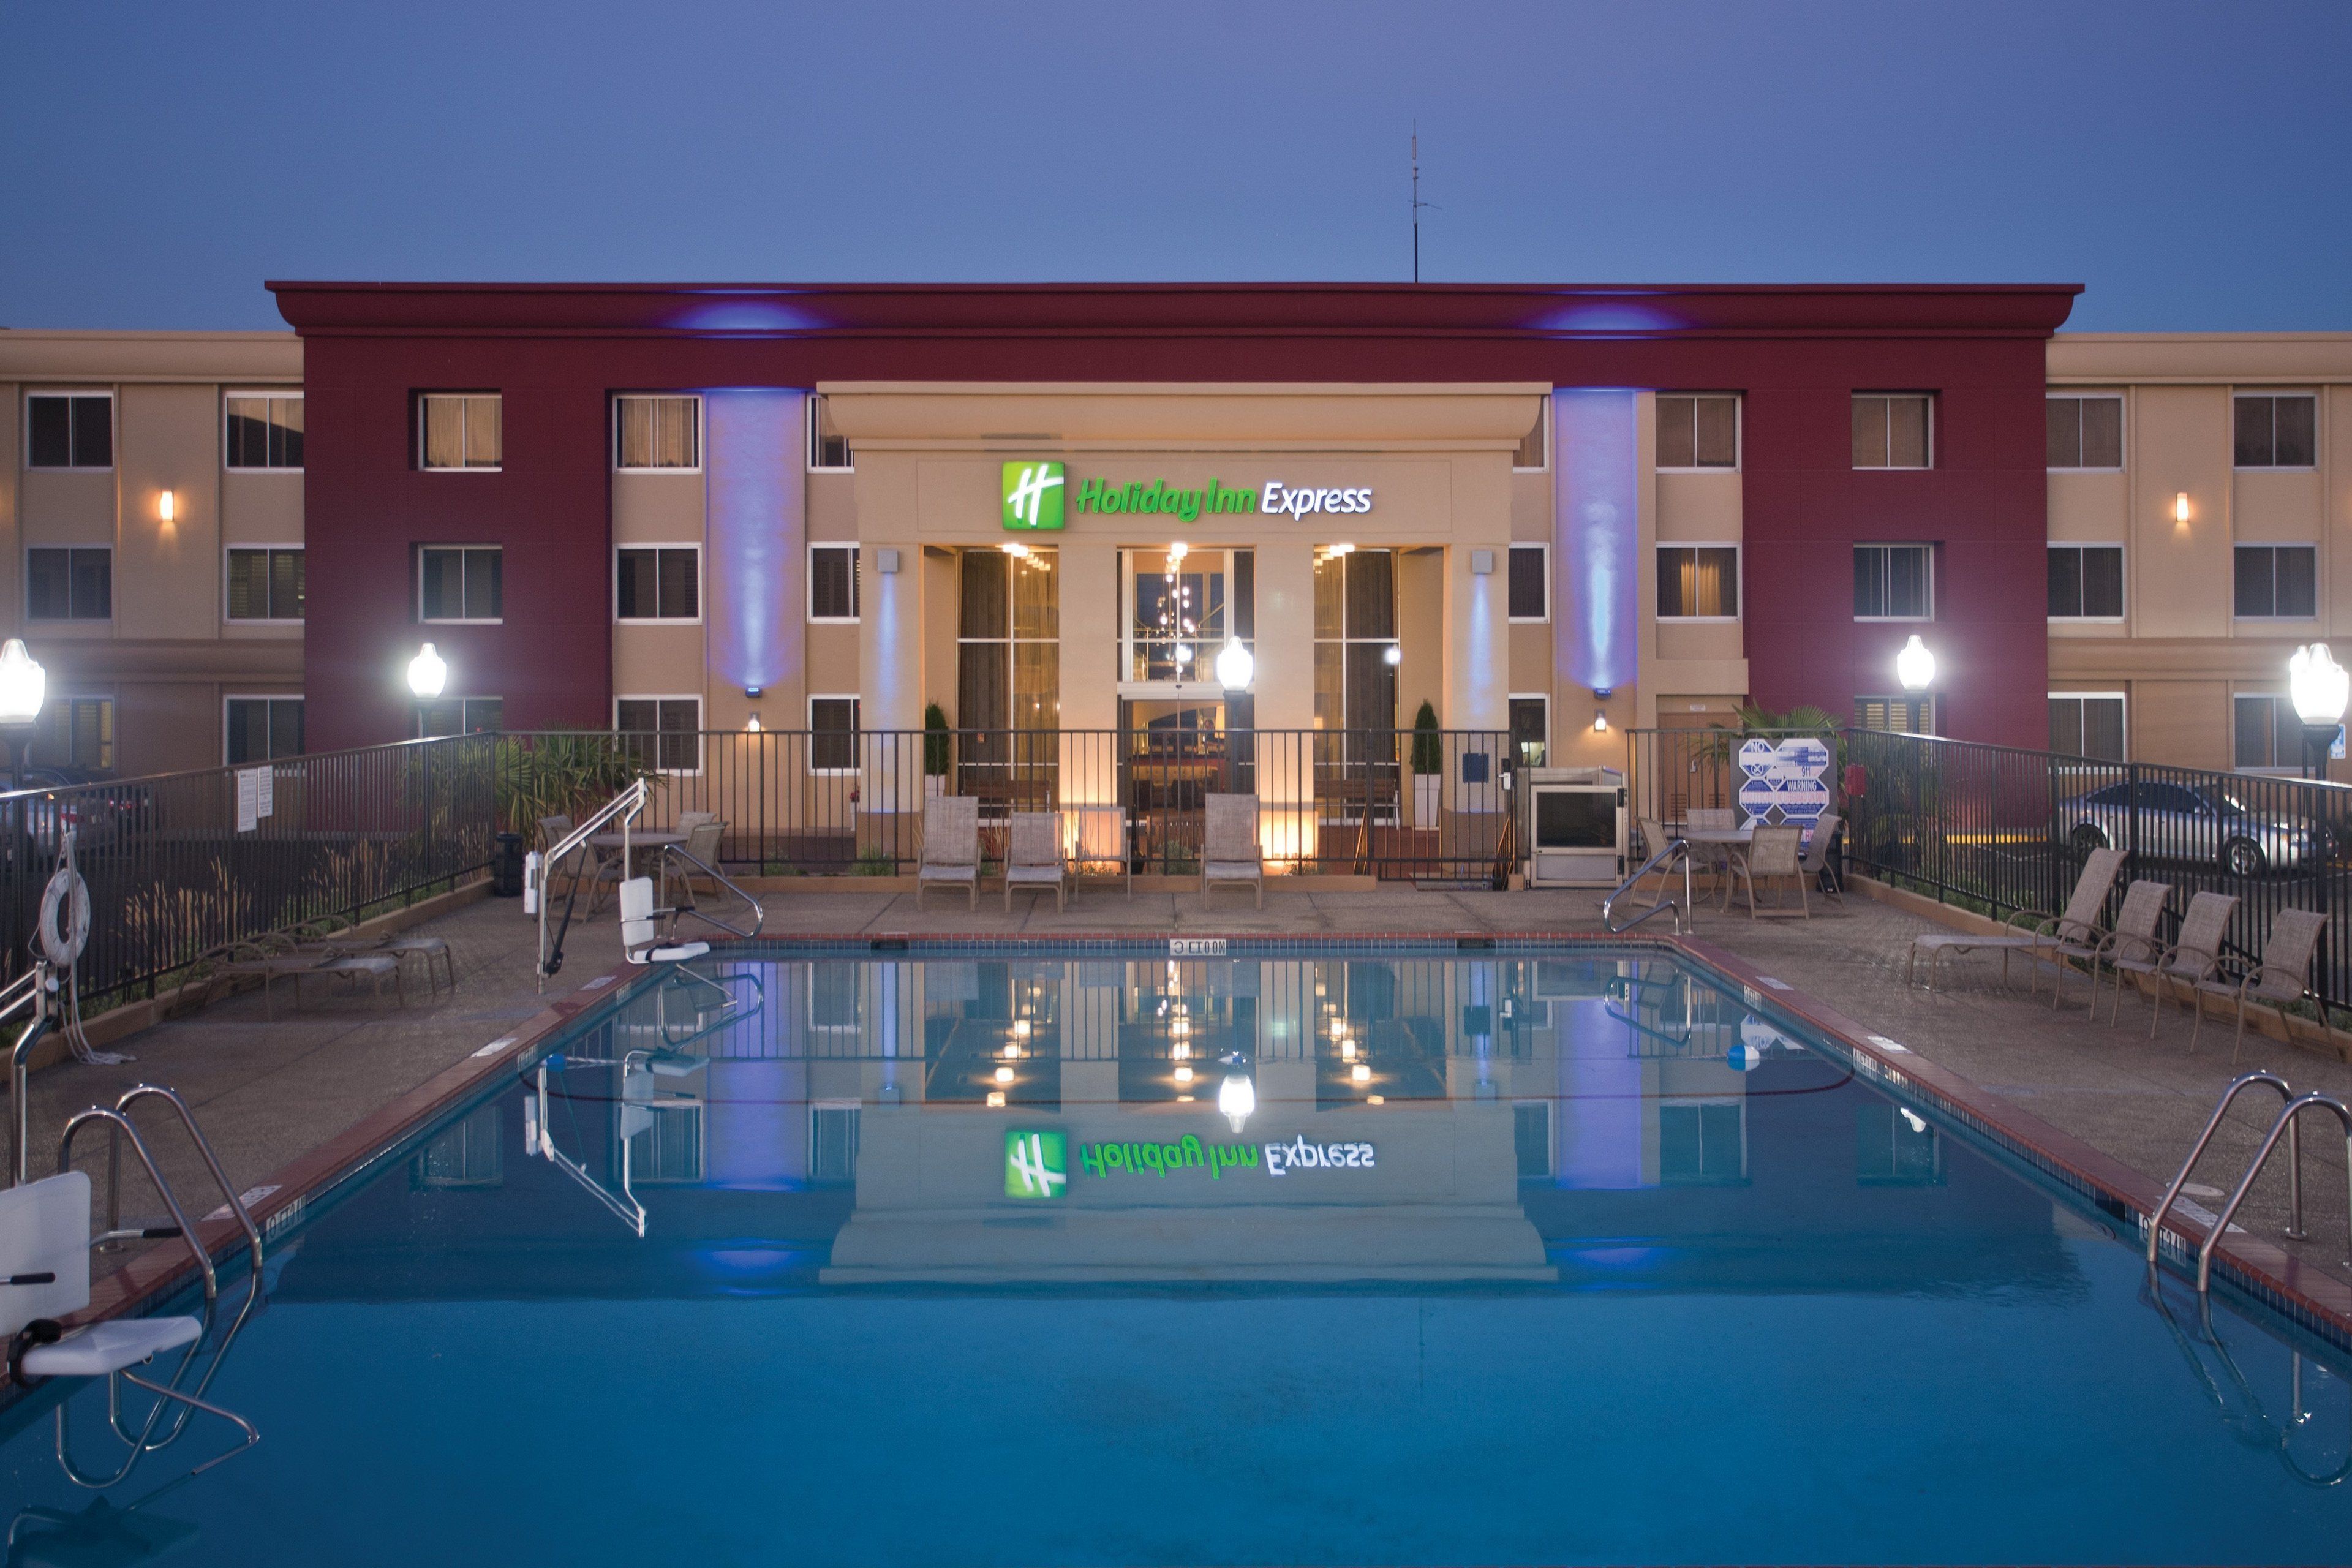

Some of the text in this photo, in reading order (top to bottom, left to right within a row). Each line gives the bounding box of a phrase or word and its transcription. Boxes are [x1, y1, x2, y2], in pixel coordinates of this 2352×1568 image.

[1076, 477, 1372, 522] Holiday Inn Express
[1751, 742, 1765, 752] NO
[1801, 766, 1811, 777] 911
[1787, 780, 1817, 791] WARNING
